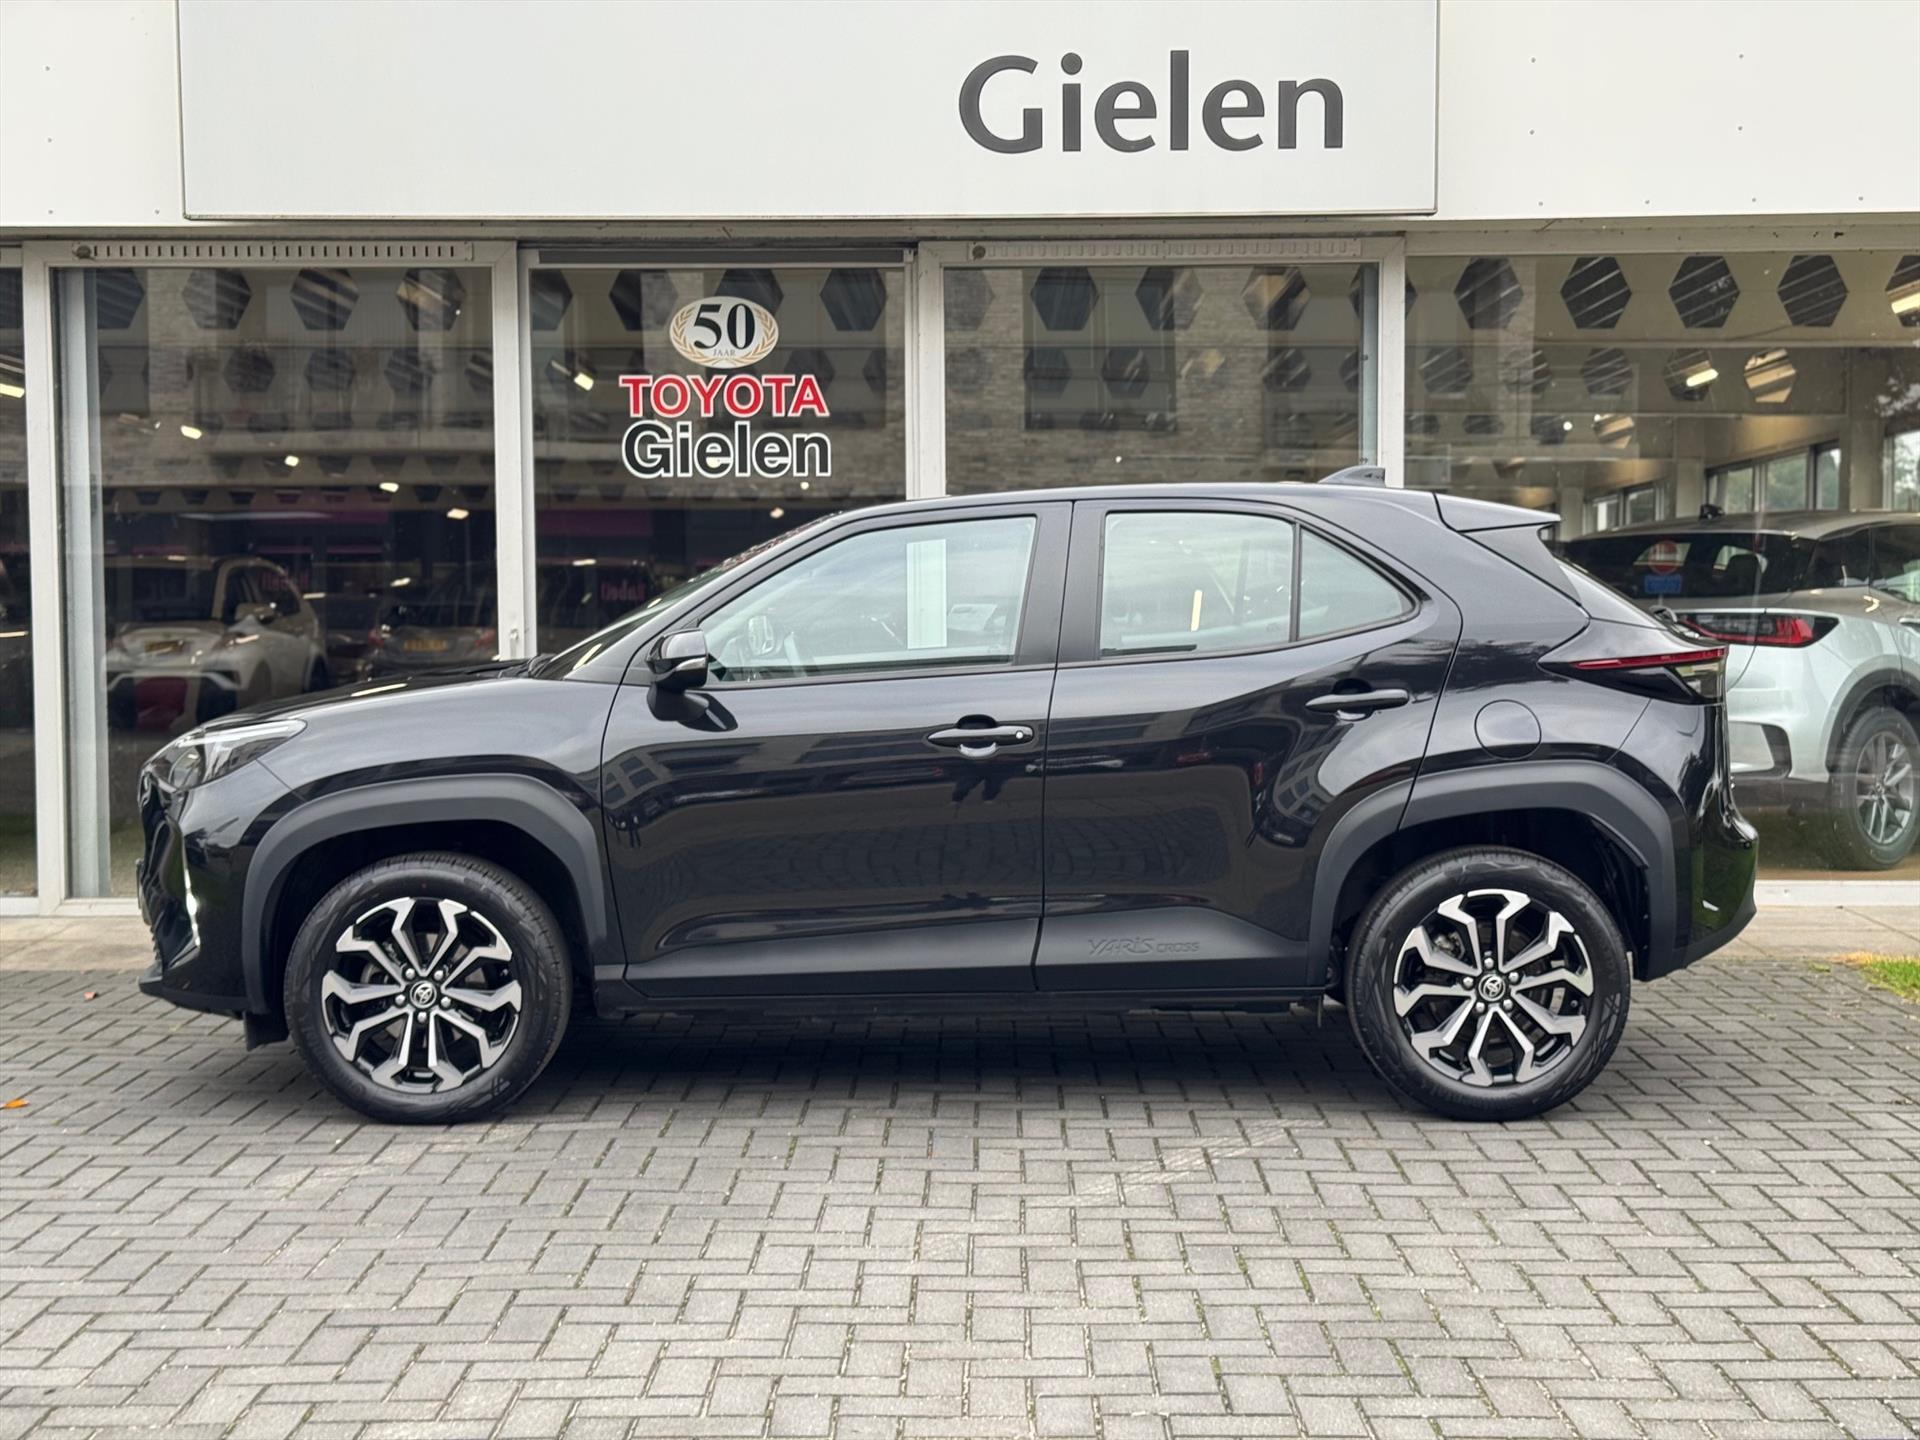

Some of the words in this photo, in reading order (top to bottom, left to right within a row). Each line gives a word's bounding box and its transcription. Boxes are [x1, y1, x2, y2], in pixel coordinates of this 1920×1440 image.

[958, 49, 1344, 155] Gielen
[693, 302, 756, 350] 50
[712, 348, 736, 358] JAAR
[618, 374, 831, 418] TOYOTA
[621, 419, 833, 479] Gielen
[1156, 941, 1201, 954] CROSS
